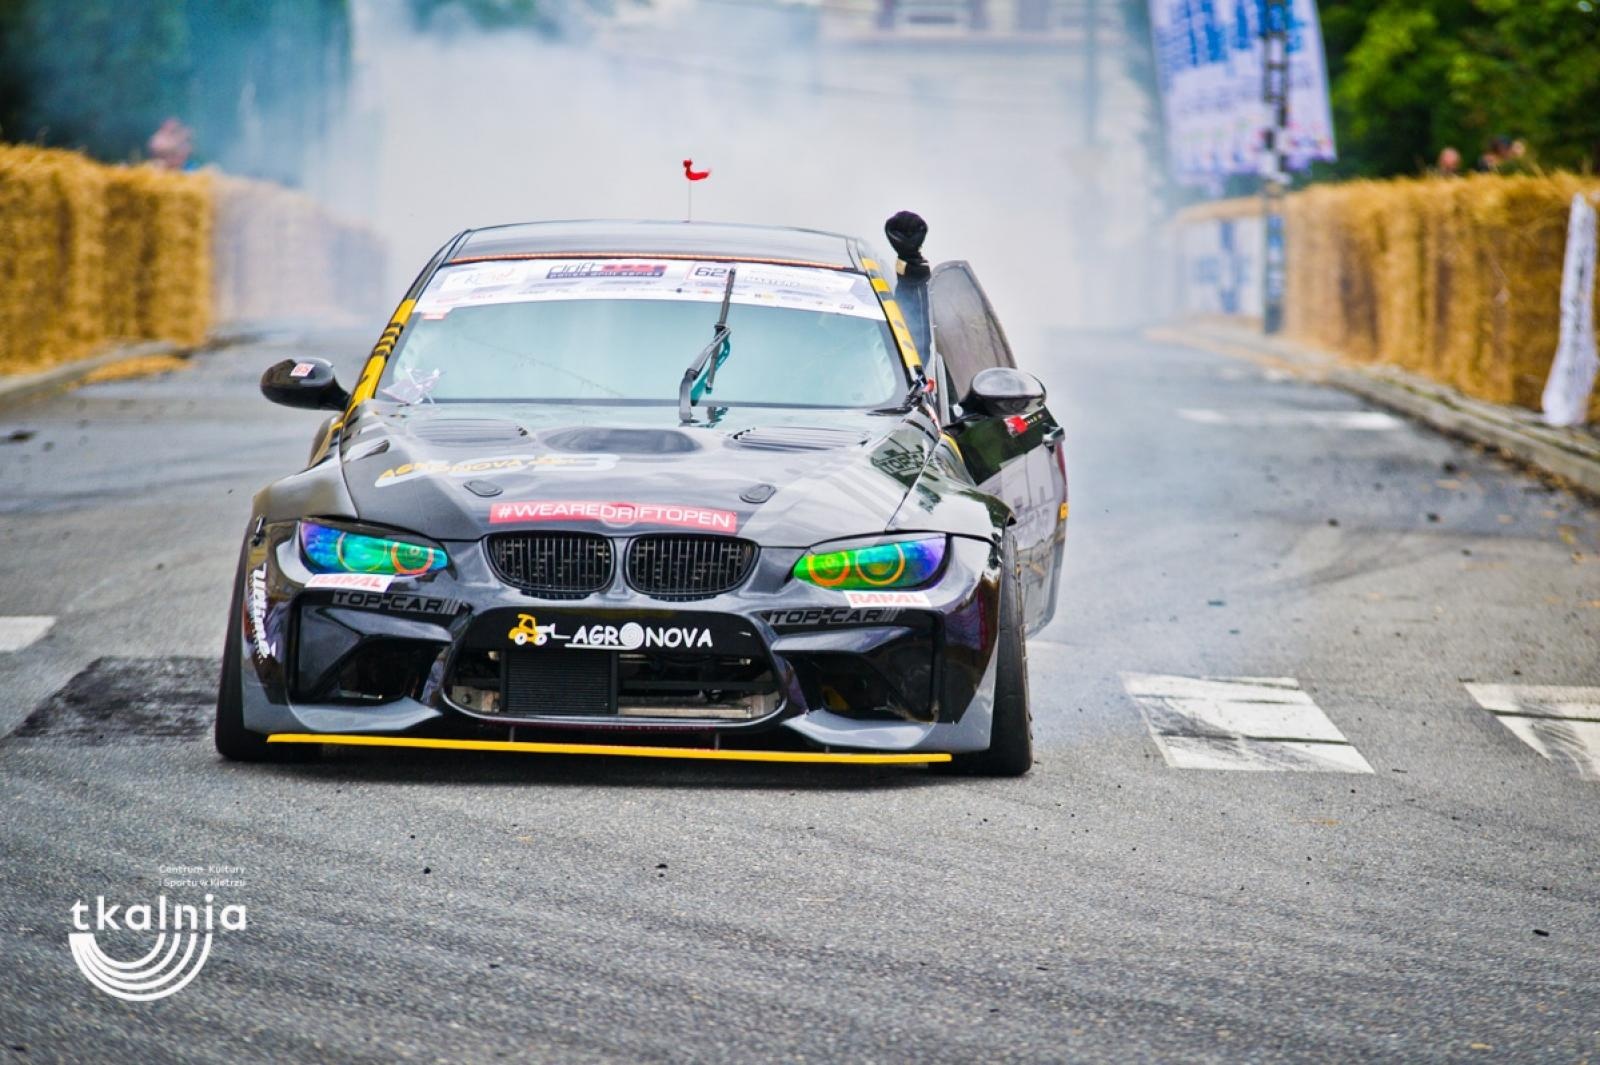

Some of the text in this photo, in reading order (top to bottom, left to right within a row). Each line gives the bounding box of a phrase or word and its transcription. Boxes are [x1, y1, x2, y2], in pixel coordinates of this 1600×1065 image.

[694, 265, 728, 278] 62
[499, 502, 731, 528] #WEAREDRIFTOPEN
[333, 591, 445, 613] TOP-CAR
[772, 610, 883, 625] TOP-CAR
[572, 621, 713, 649] AGRONOVA
